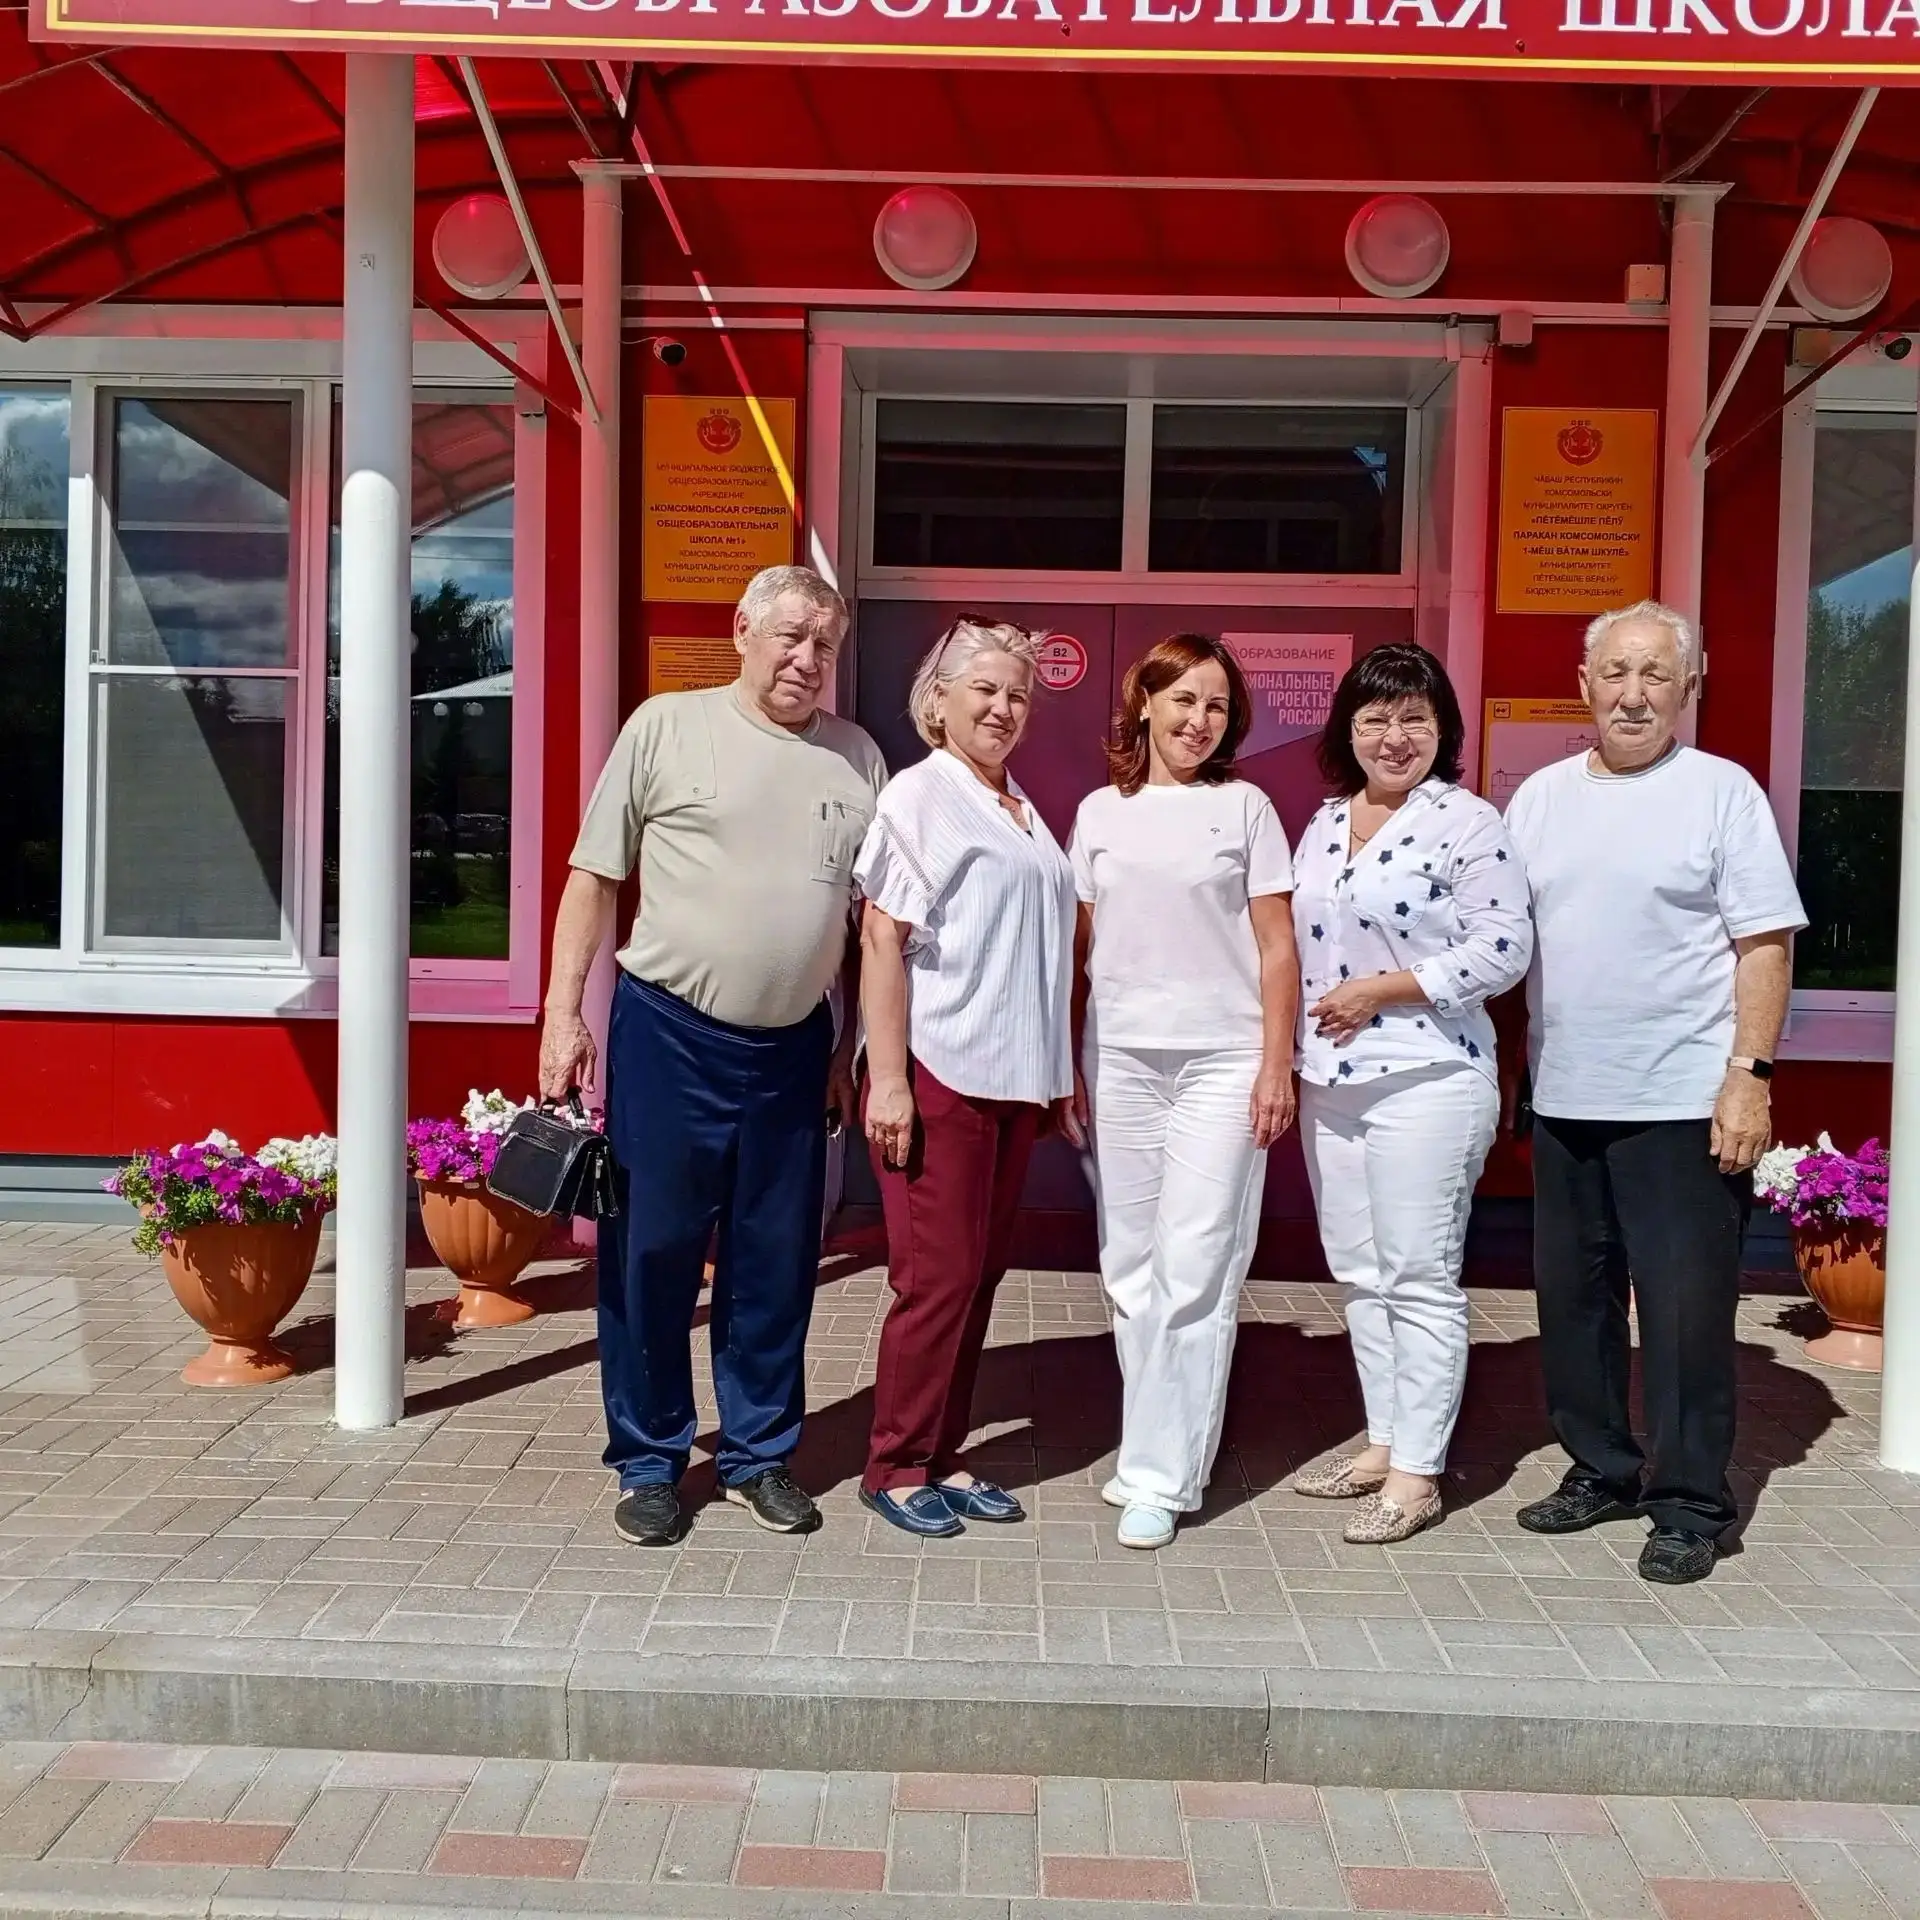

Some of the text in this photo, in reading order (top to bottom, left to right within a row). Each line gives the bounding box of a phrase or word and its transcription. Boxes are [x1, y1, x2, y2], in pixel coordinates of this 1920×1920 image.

[650, 504, 786, 515] «КОМСОМОЛЬСКАЯ СРЕДНЯЯ
[656, 519, 779, 530] ОБЩЕОБРАЗОВАТЕЛЬНАЯ
[689, 535, 724, 544] ШКОЛА
[1513, 531, 1641, 542] ПАРАКАН КОМСОМОЛЬСКИ
[680, 549, 756, 559] КОМСОМОЛЬСКОГО
[664, 562, 768, 573] МУНИЦИПАЛЬНОГО ОКРУ
[716, 576, 752, 585] РЕСПУБ
[1525, 587, 1561, 597] БЮДЖЕТ
[1053, 647, 1068, 658] В2
[1239, 647, 1336, 660] ОБРАЗОВАНИЕ
[1248, 671, 1333, 690] ИОНАЛЬНЫЕ
[1267, 690, 1331, 708] ПРОЕКТЫ
[1278, 708, 1331, 726] РОССИИ
